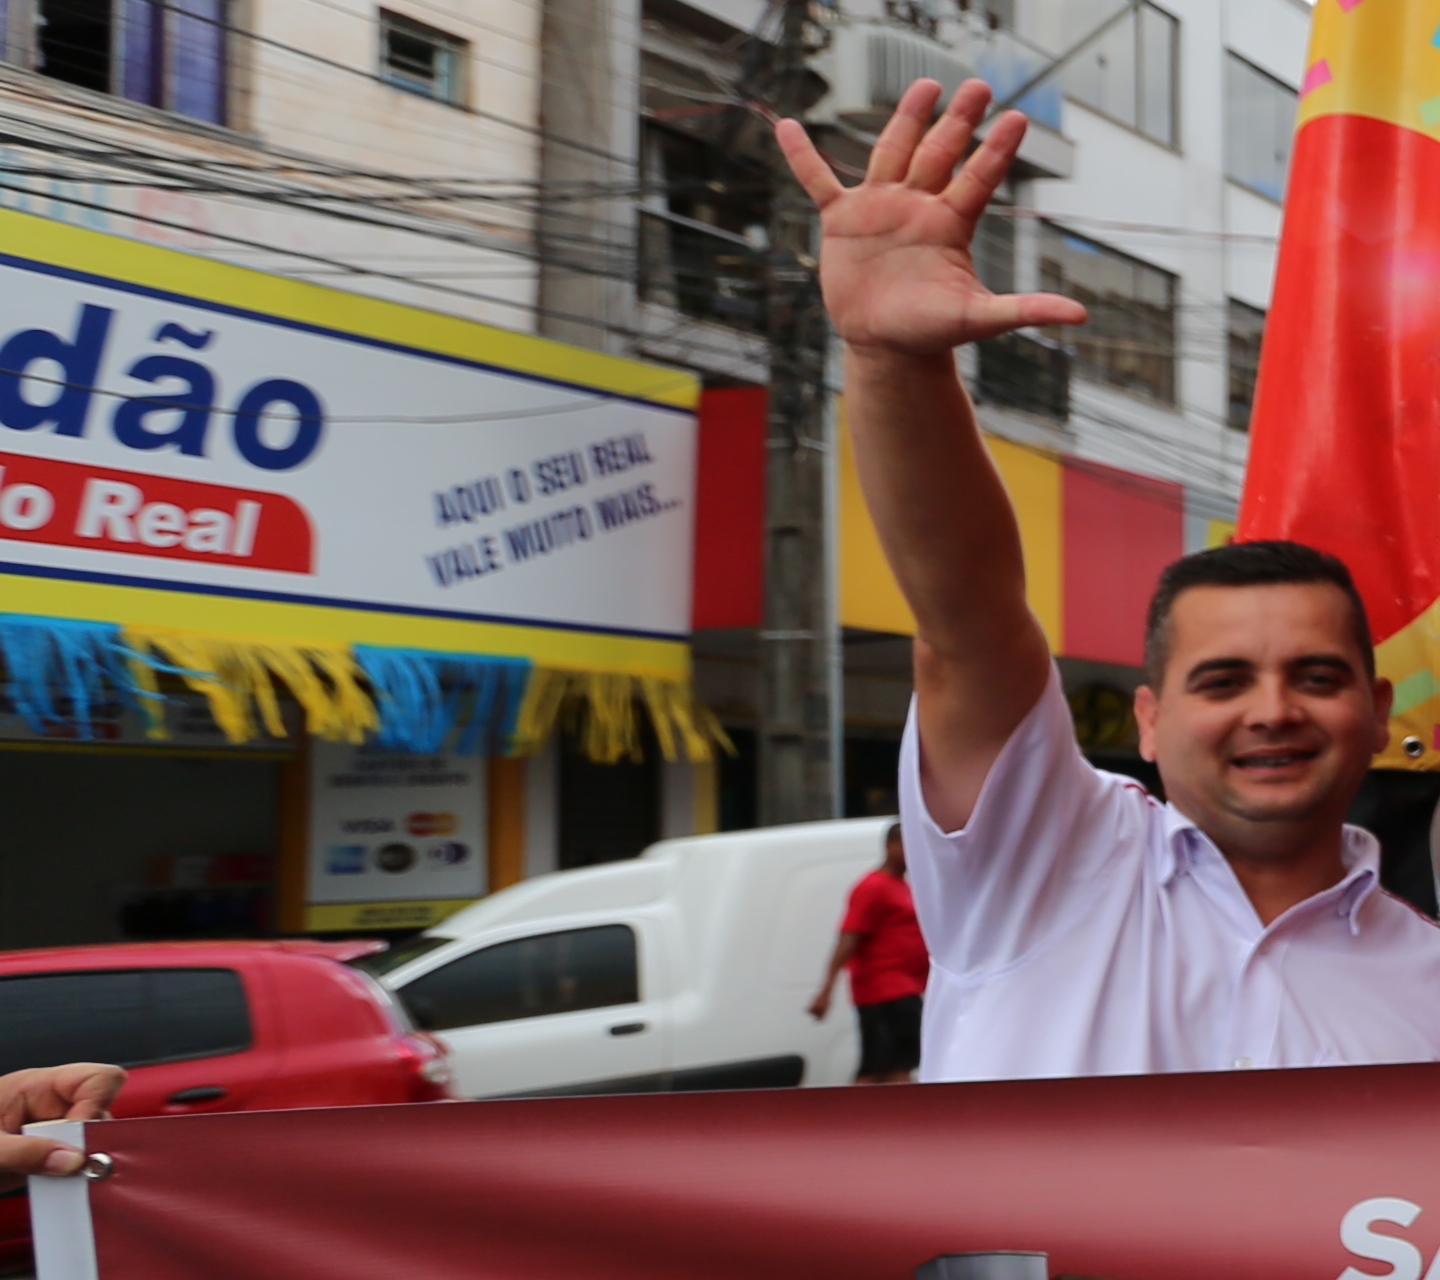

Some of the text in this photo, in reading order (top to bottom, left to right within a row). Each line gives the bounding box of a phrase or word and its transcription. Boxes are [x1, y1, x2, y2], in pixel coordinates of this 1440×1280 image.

[0, 302, 325, 471] dão
[73, 476, 263, 558] Real
[423, 535, 504, 589] VALE
